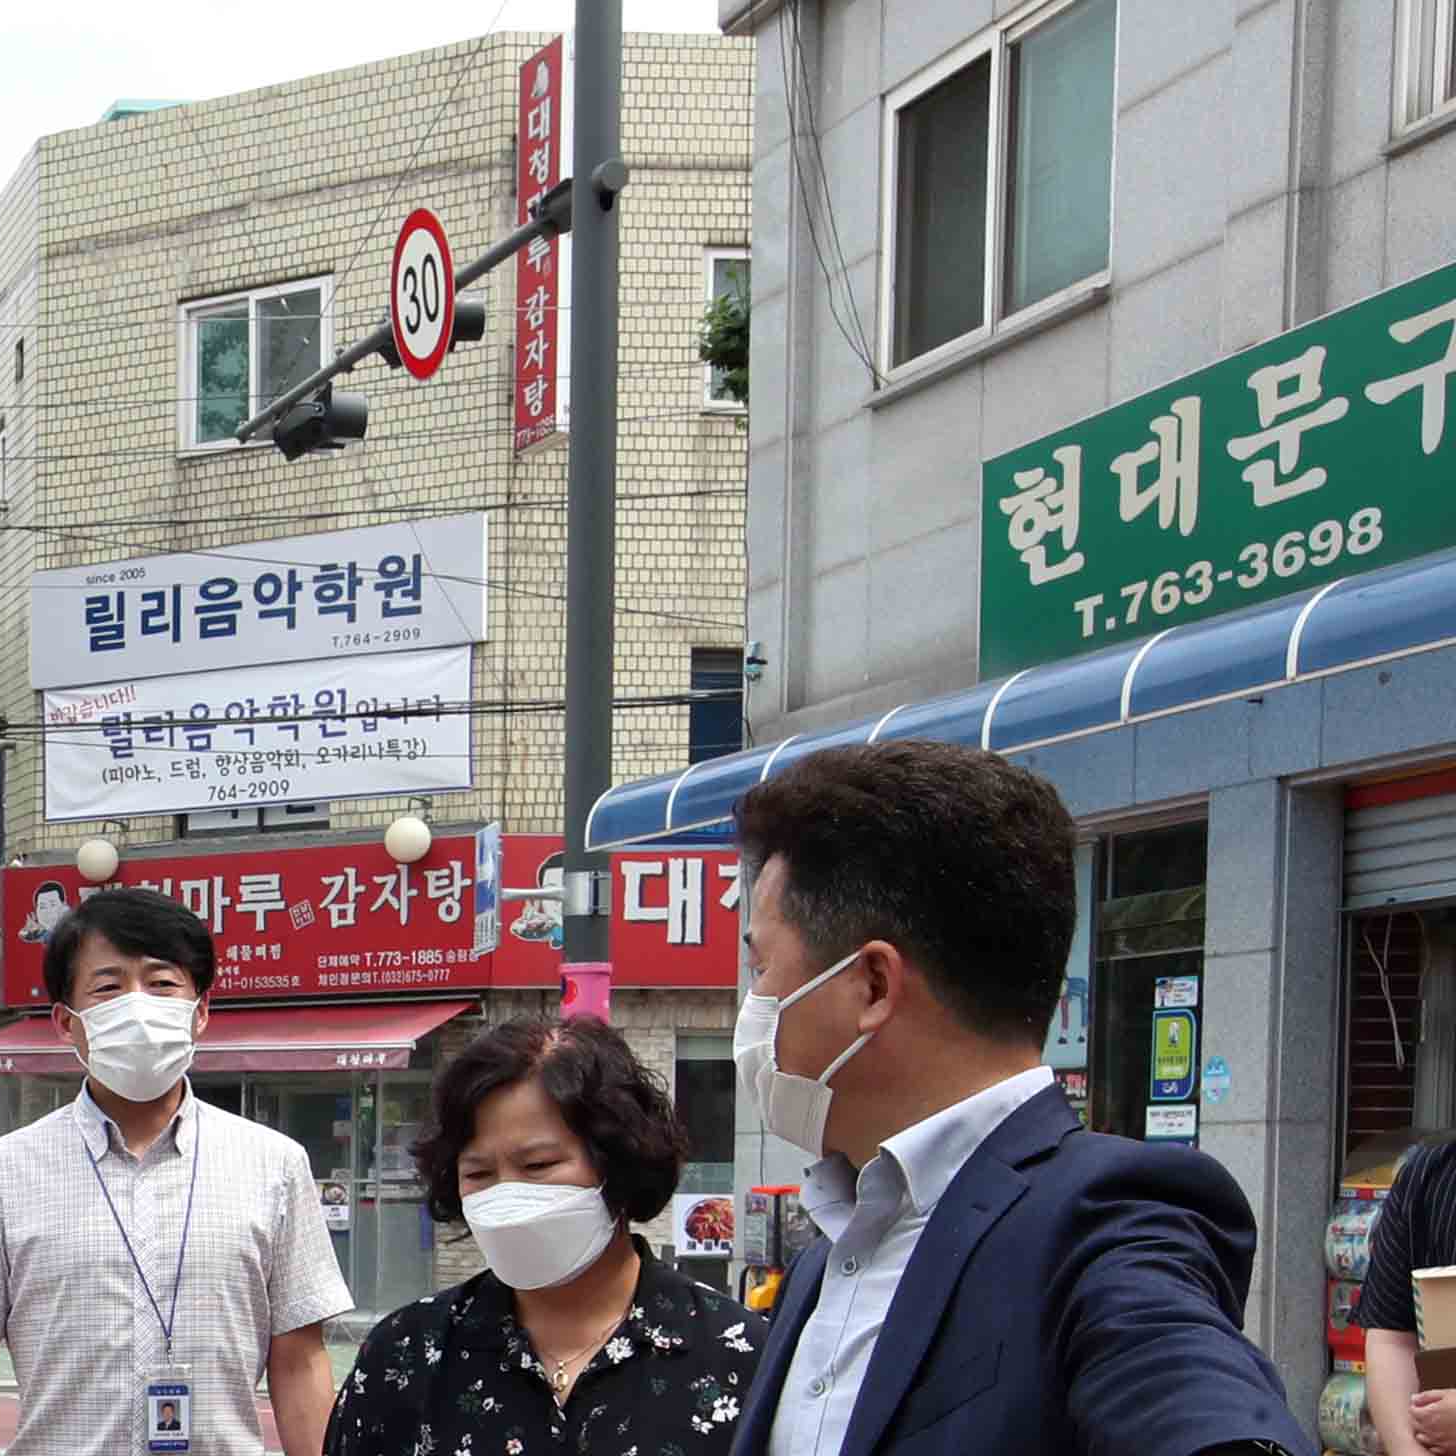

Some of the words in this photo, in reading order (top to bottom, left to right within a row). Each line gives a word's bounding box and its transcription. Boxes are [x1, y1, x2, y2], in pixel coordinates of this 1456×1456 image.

[403, 253, 439, 335] 30
[523, 286, 551, 417] 감자탕
[999, 298, 1456, 587] 현대문구
[85, 553, 422, 653] 릴리음악학원
[86, 572, 116, 584] since
[120, 567, 146, 581] 2005
[1074, 507, 1384, 638] T.763-3698
[332, 627, 421, 649] T.764-2909
[207, 780, 290, 801] 764-2909
[319, 860, 472, 929] 감자탕
[364, 949, 443, 967] T.773-1885
